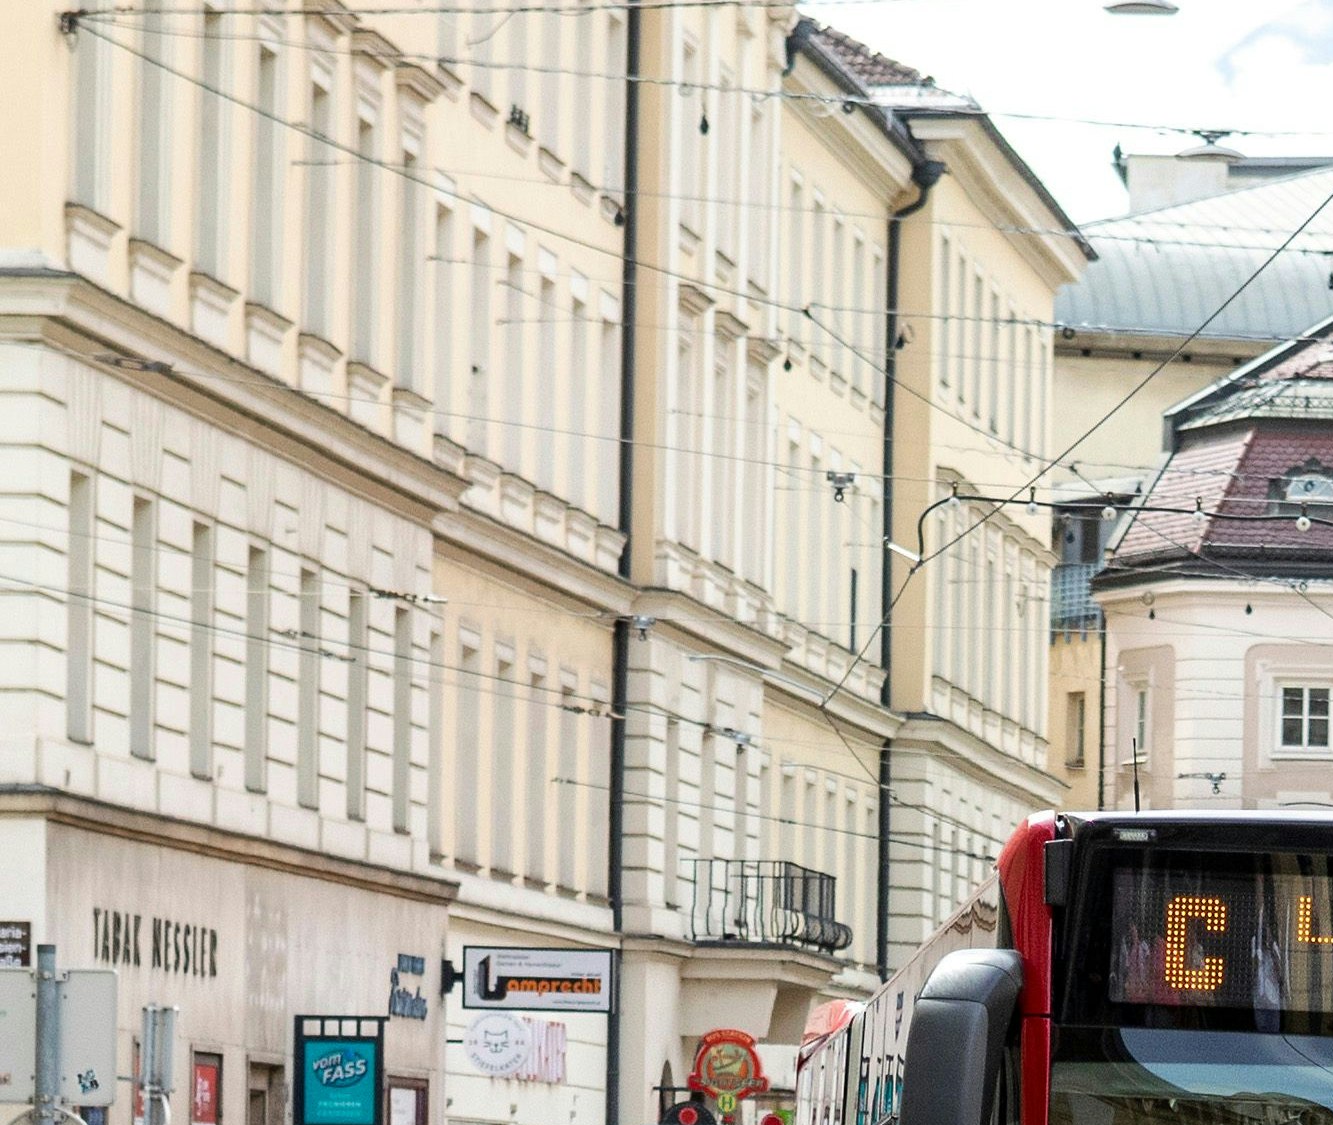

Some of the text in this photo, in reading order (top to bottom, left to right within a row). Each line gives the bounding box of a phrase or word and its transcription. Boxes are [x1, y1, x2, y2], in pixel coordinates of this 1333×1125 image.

[93, 908, 217, 978] TABAK NESSLER
[1165, 896, 1227, 991] C
[313, 1053, 341, 1070] vom
[322, 1060, 367, 1085] FASS
